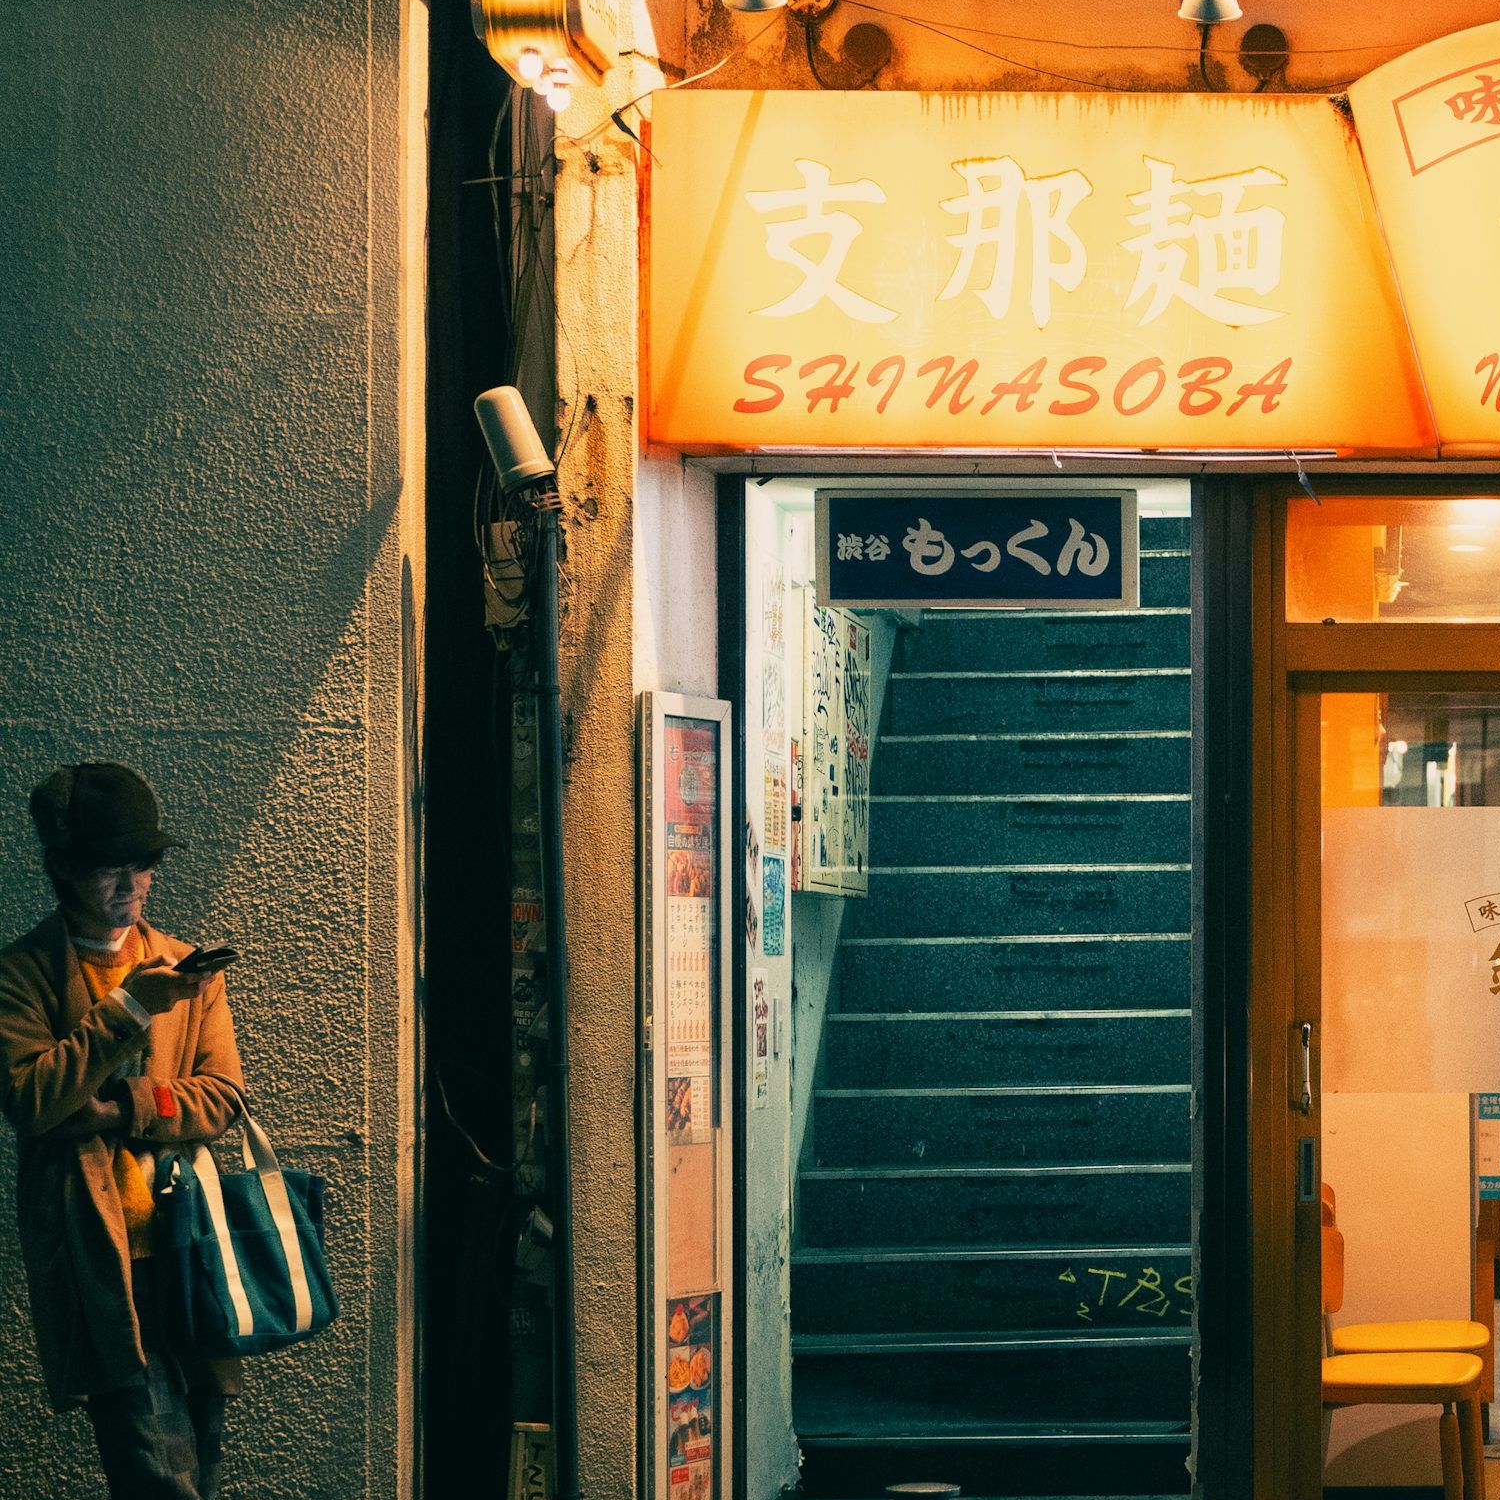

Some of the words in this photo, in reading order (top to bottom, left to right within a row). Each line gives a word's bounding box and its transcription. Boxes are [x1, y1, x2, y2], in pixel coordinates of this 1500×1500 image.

[744, 154, 1291, 331] 支那麺
[733, 353, 1295, 417] SHINASOBA
[837, 533, 891, 562] 渋谷
[902, 518, 1110, 577] もっくん
